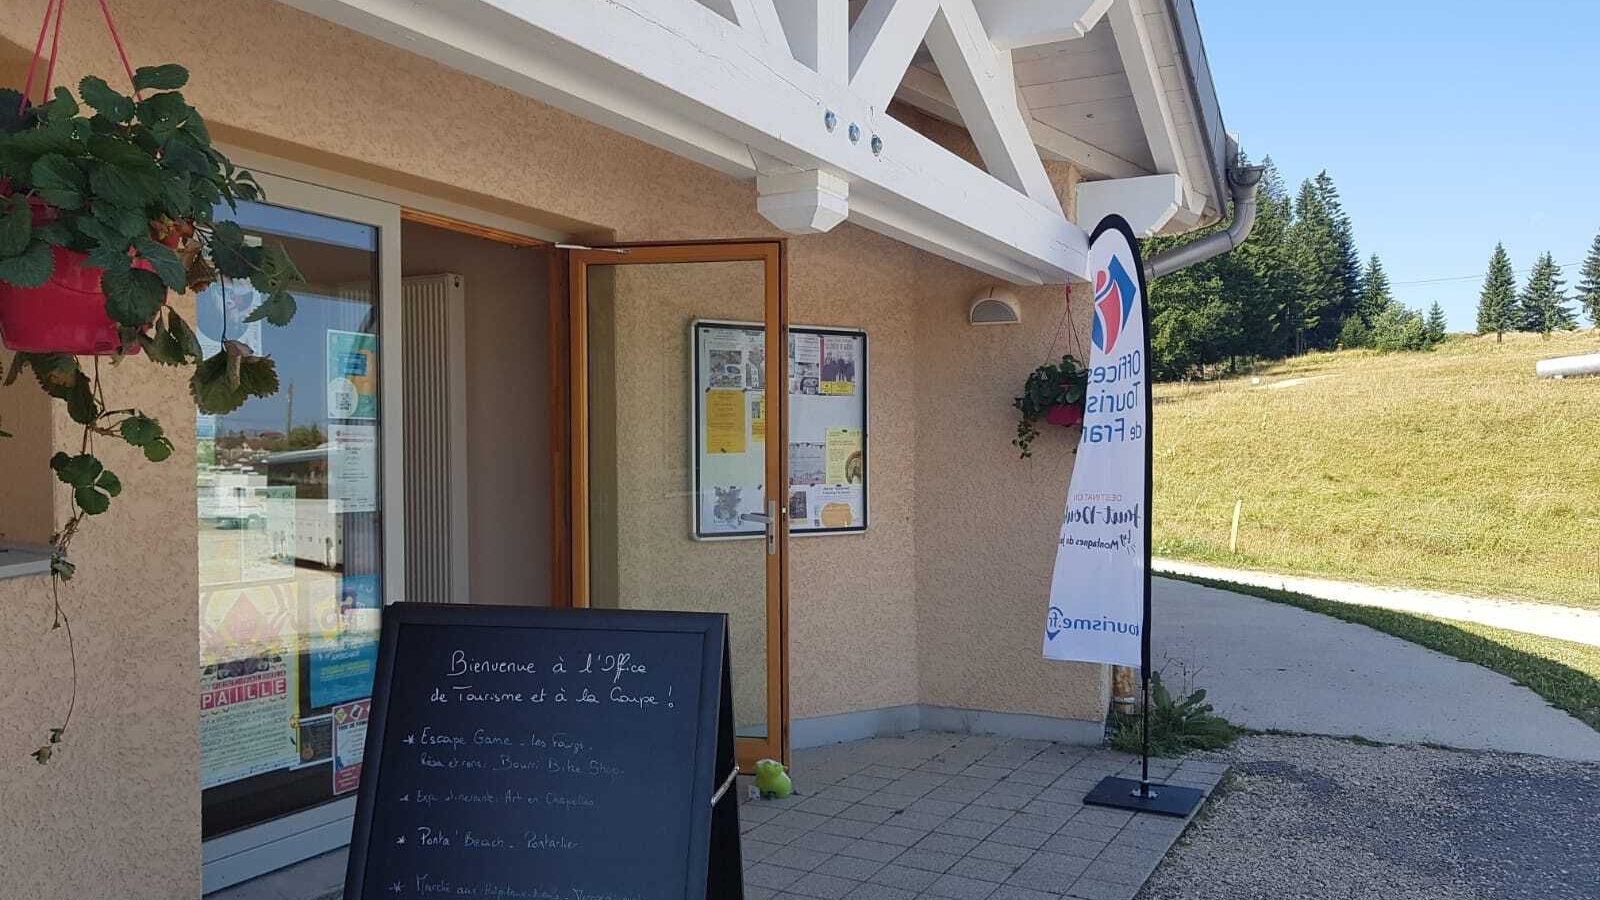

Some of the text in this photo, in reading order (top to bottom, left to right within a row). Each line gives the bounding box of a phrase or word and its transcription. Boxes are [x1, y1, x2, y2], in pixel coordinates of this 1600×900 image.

[446, 649, 537, 676] Bienvenue
[552, 656, 568, 674] à
[201, 679, 285, 707] PAILLE
[431, 688, 448, 703] de
[452, 685, 523, 704] Tourisme
[531, 688, 546, 703] et
[555, 688, 568, 703] à
[576, 688, 600, 703] la
[421, 727, 466, 750] Escape
[473, 729, 513, 746] Game
